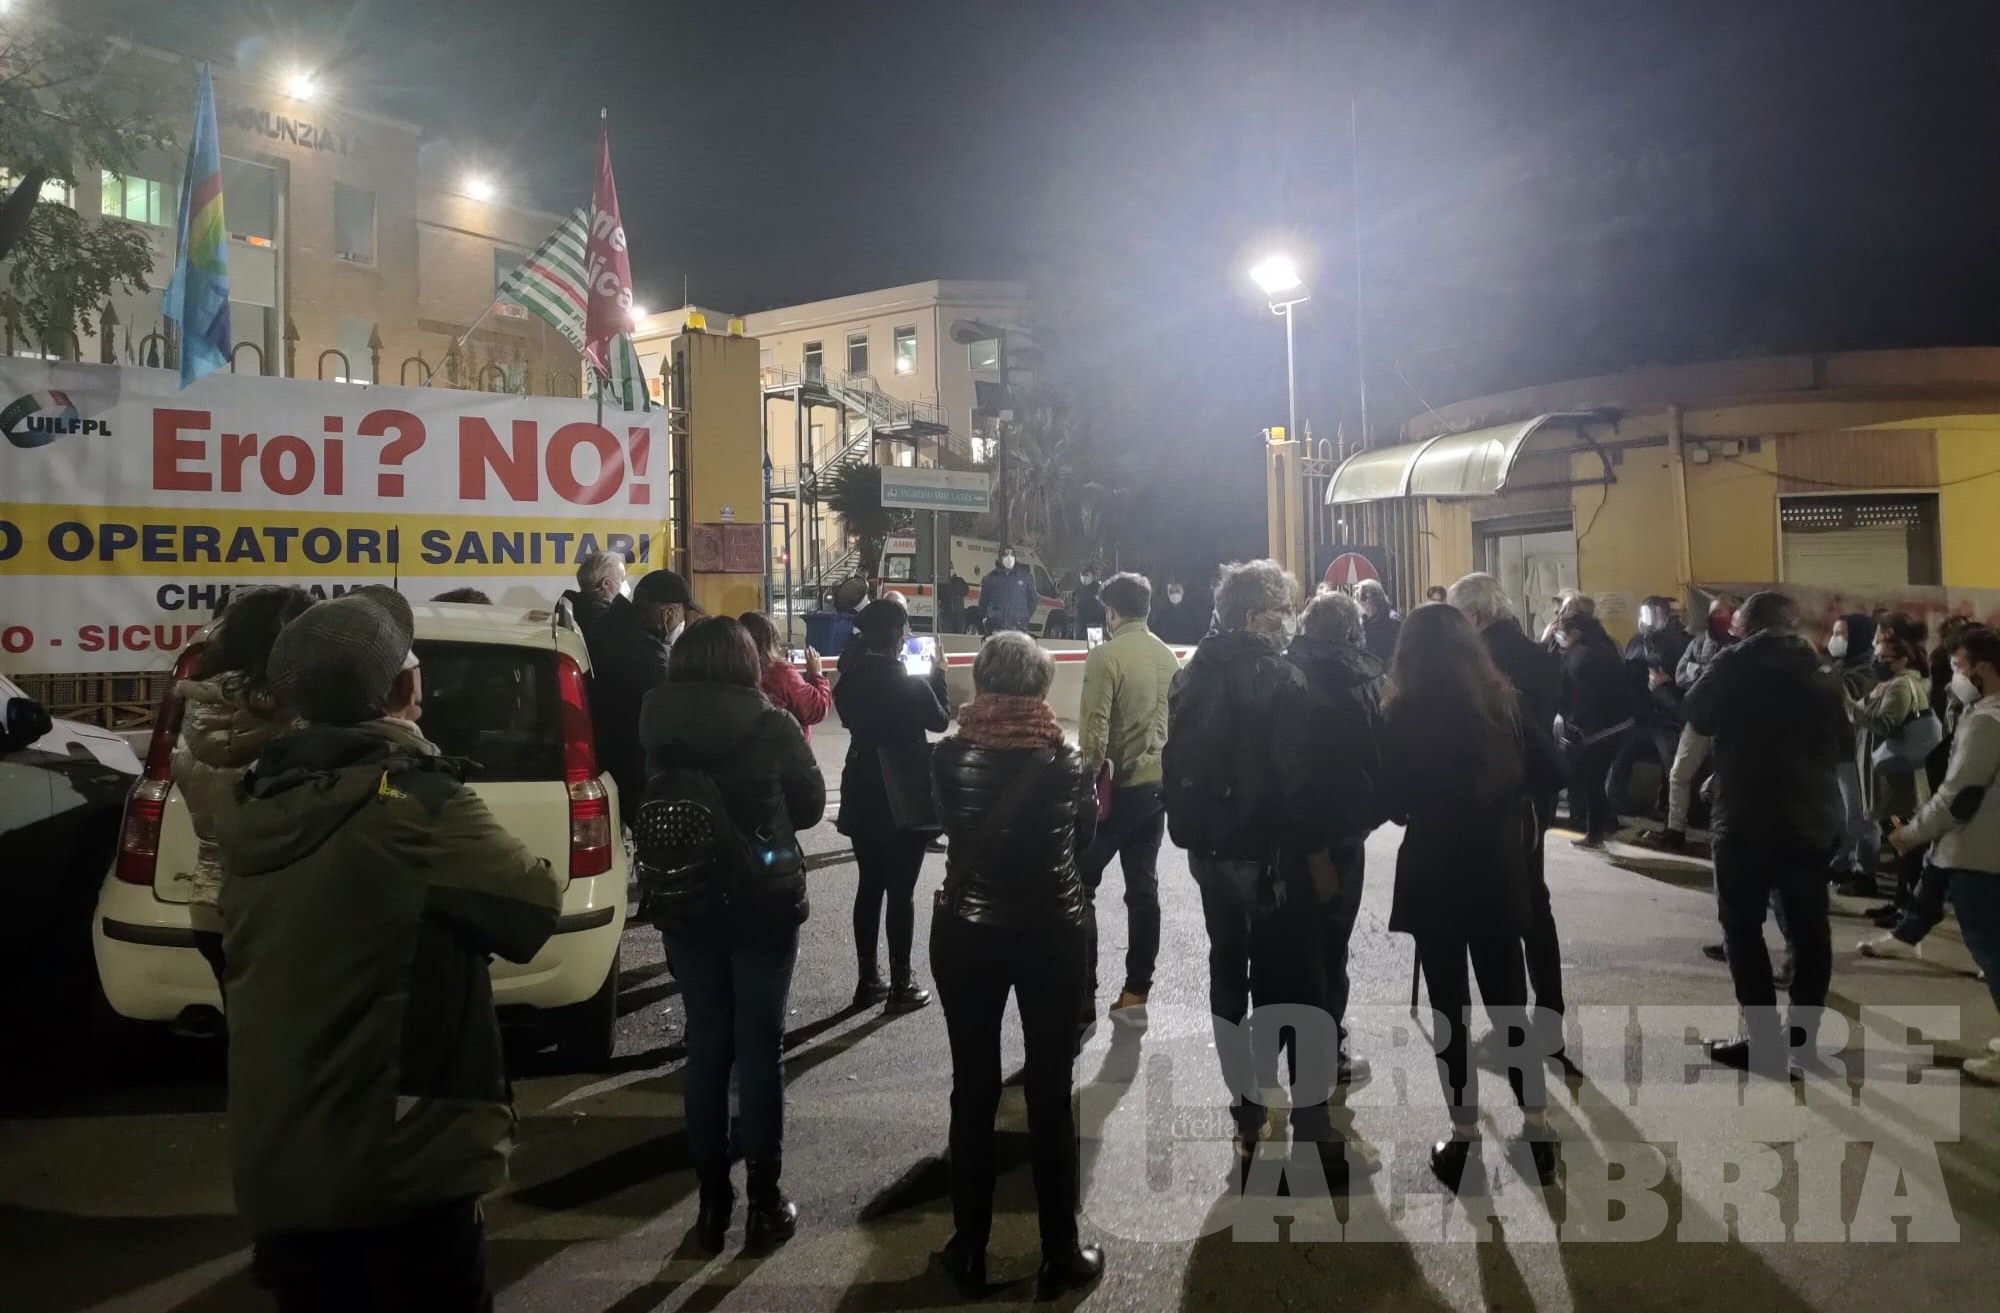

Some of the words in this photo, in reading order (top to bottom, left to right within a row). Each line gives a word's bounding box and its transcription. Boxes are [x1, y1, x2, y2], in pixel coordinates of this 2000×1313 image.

[26, 416, 112, 436] UILFPL
[152, 407, 427, 498] Eroi?
[458, 415, 651, 505] NO!
[47, 521, 400, 564] OPERATORI
[420, 528, 651, 565] SANITARI
